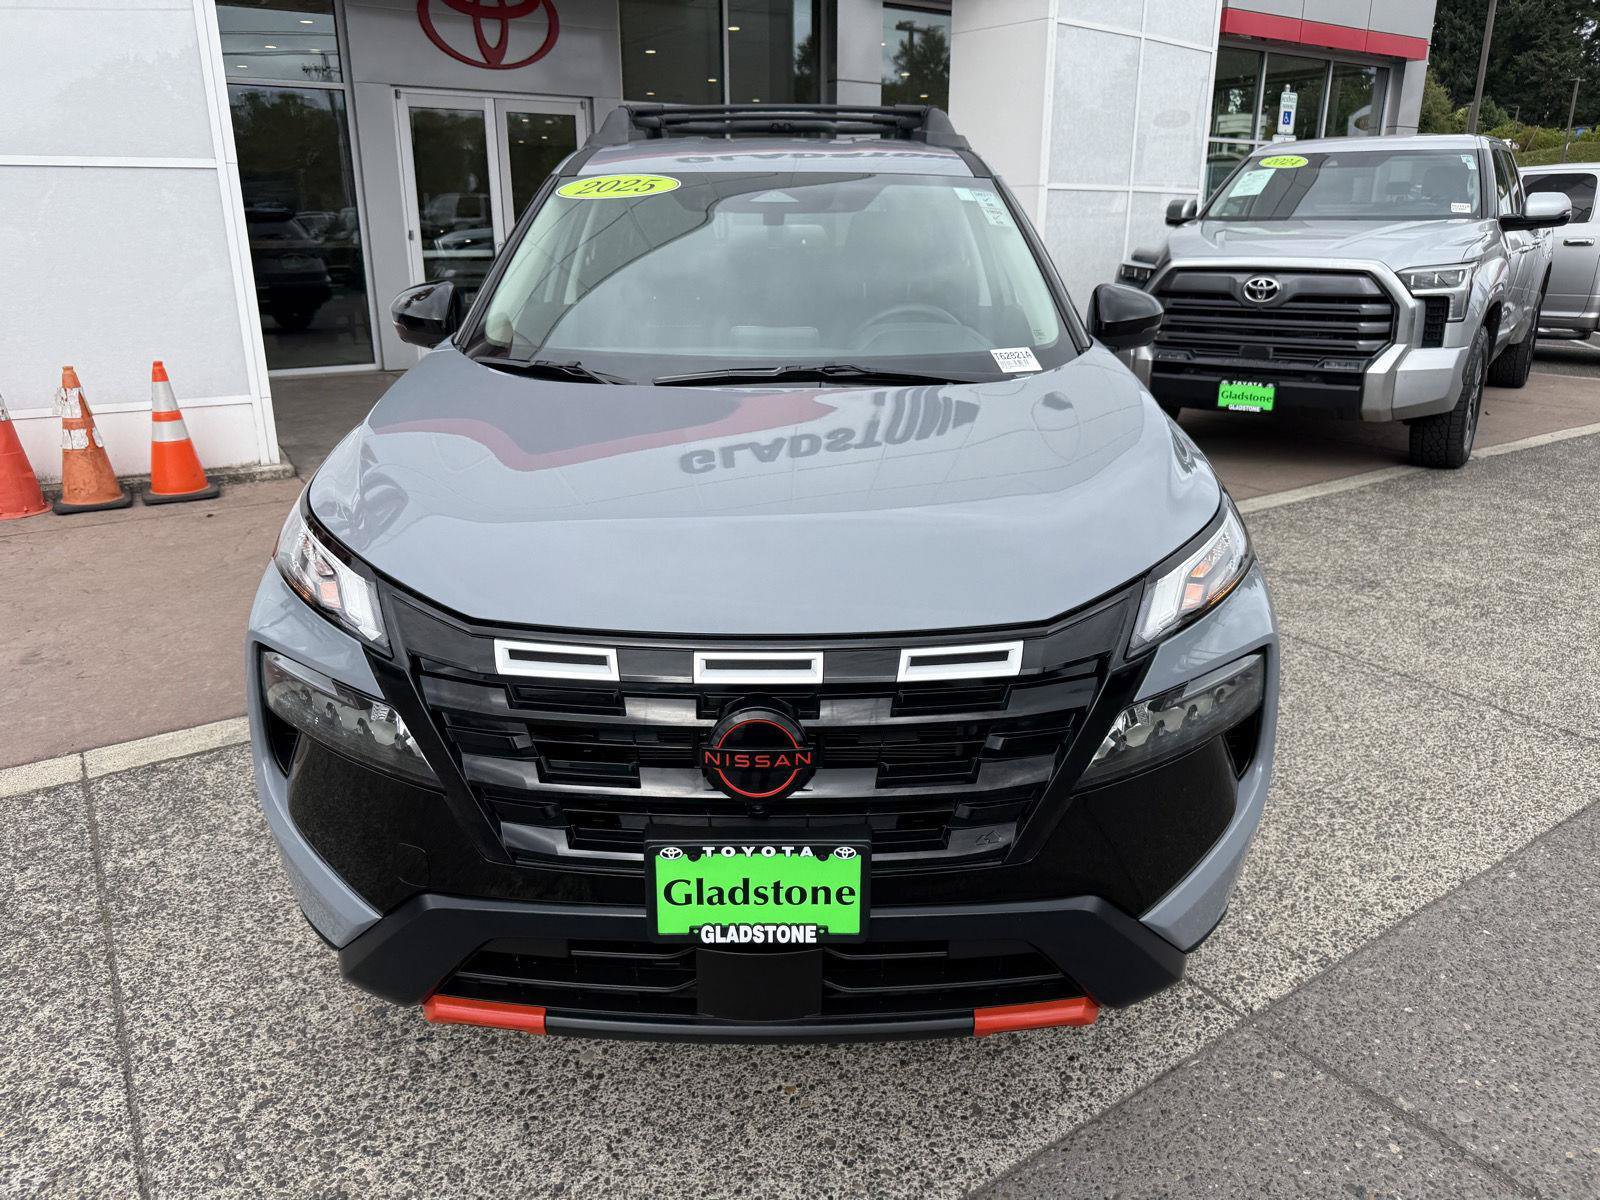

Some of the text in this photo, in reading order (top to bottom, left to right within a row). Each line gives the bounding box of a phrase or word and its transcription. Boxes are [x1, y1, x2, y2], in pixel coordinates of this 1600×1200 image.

[575, 179, 662, 195] 2025
[1221, 390, 1272, 403] Gladstone
[704, 751, 812, 768] NISSAN
[702, 846, 814, 858] TOYOTA
[663, 878, 856, 906] Gladstone
[700, 925, 817, 944] GLADSTONE
